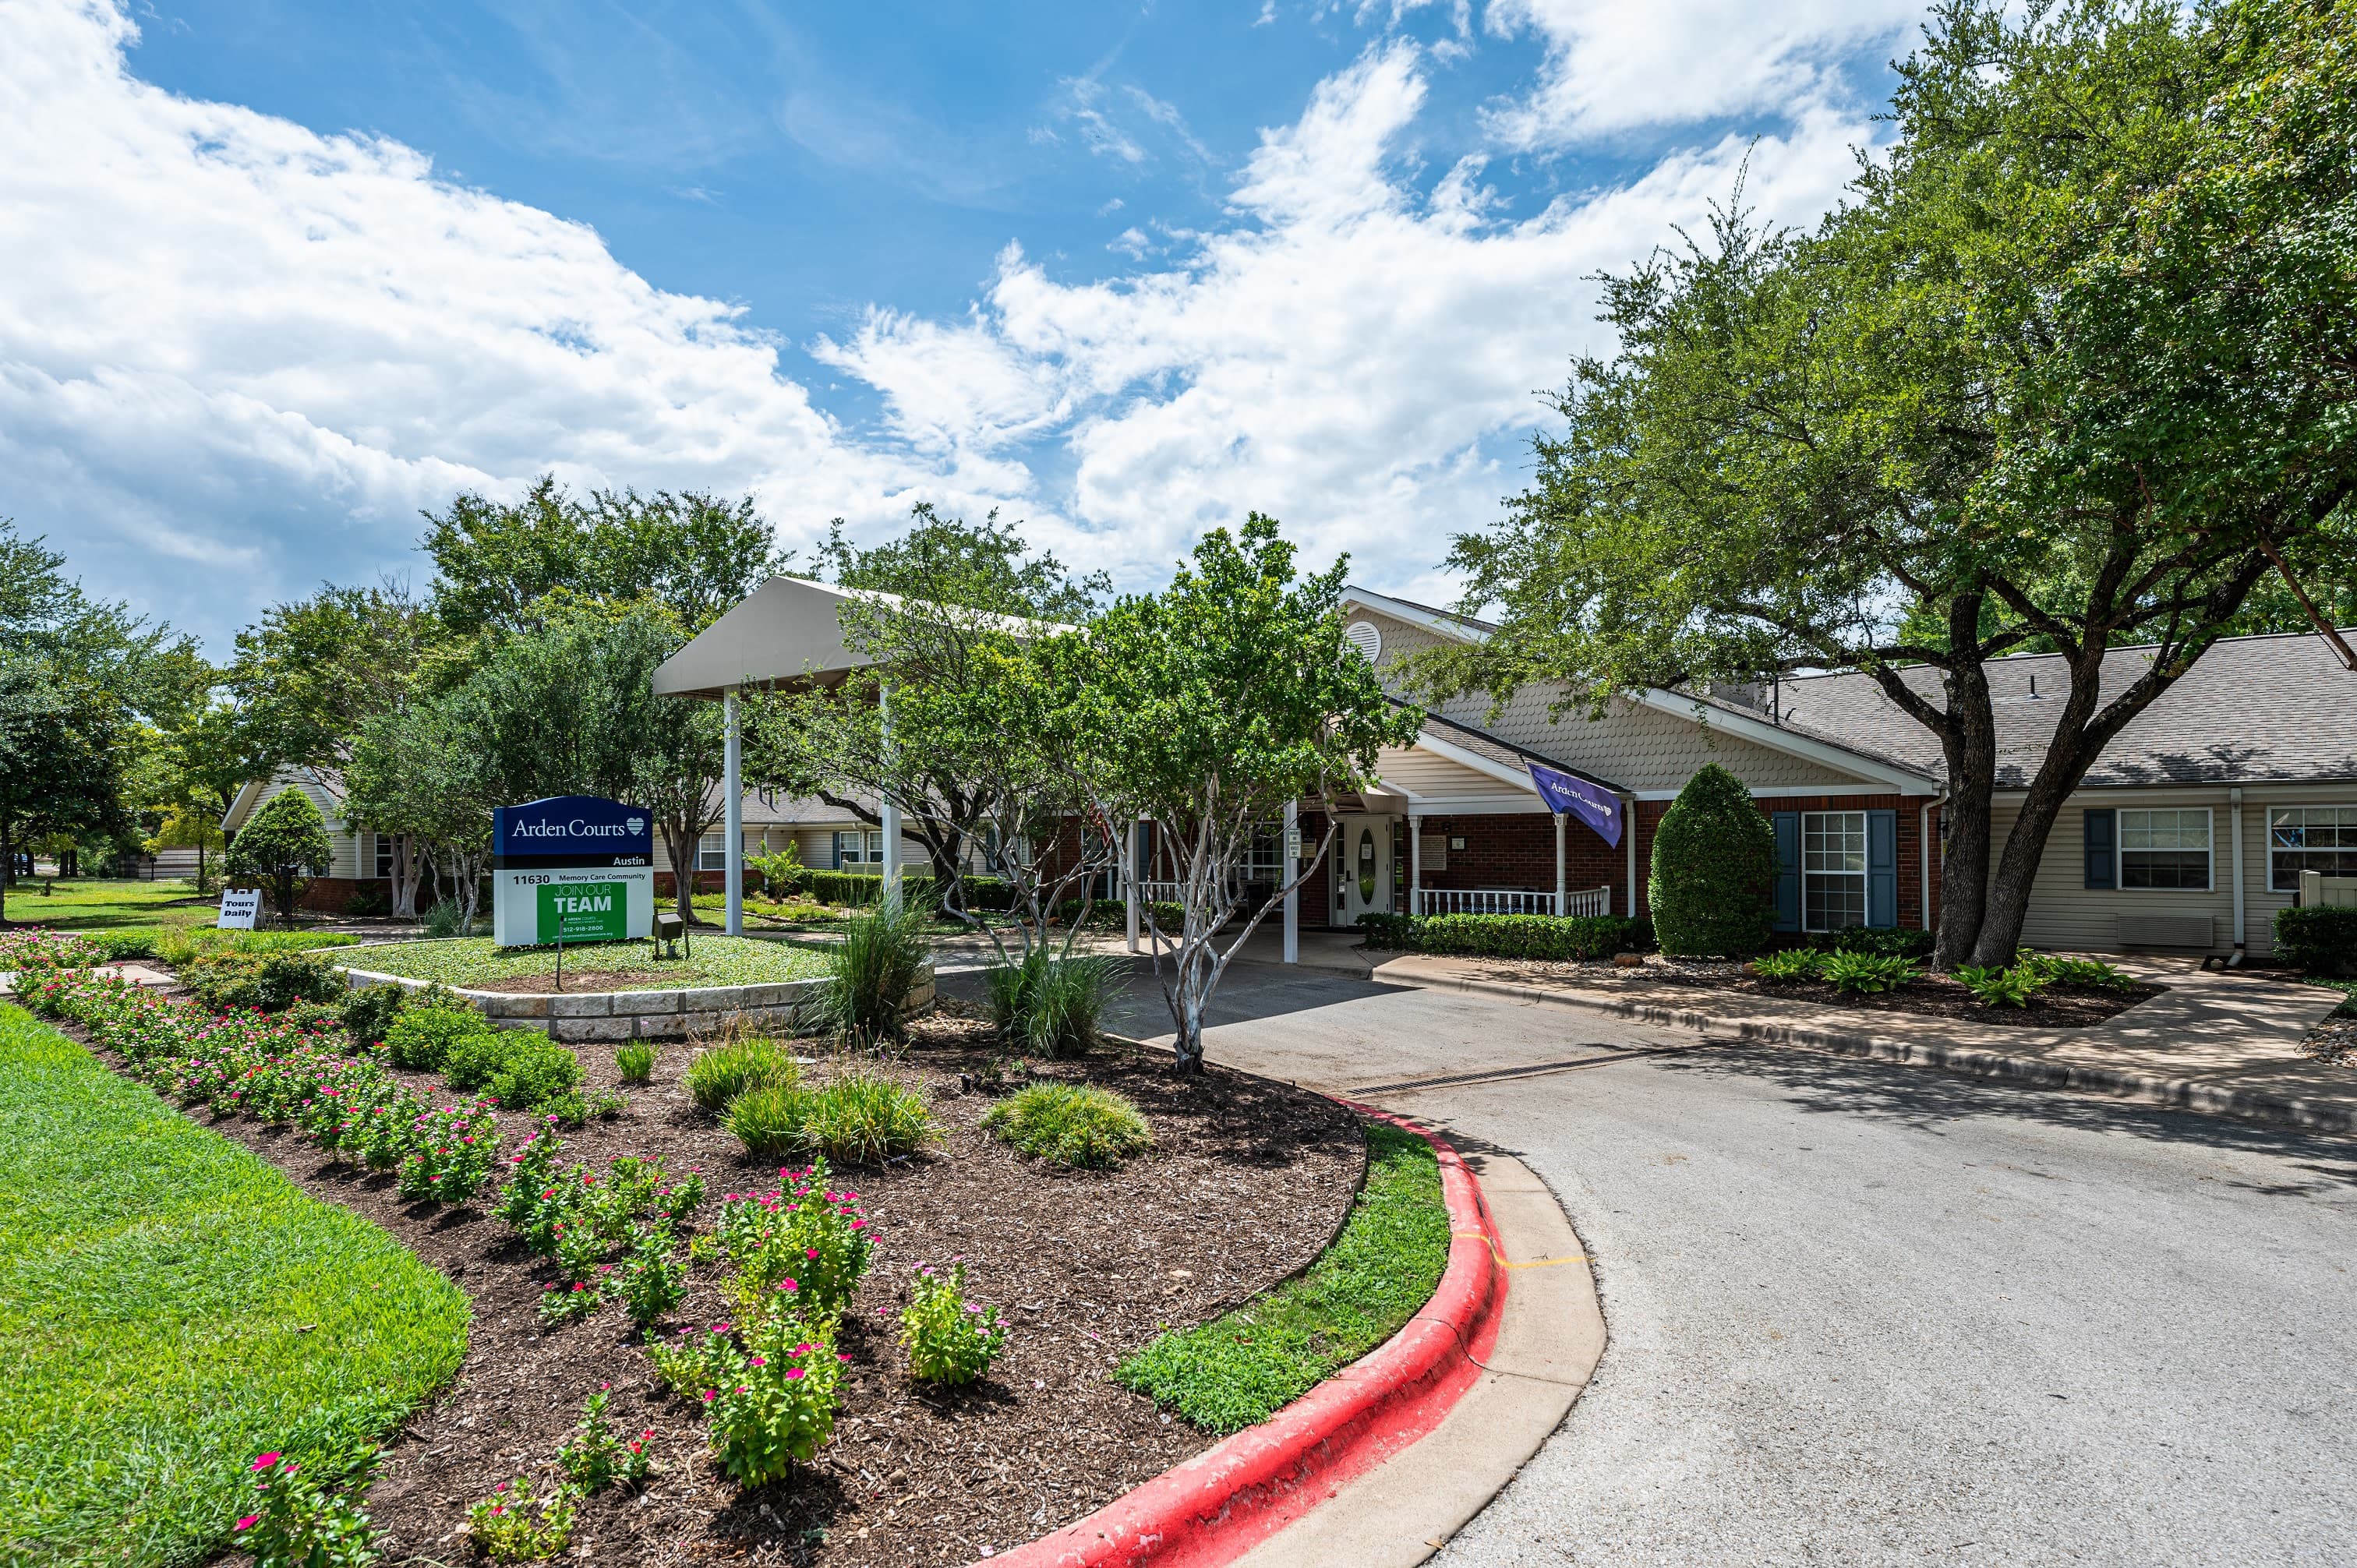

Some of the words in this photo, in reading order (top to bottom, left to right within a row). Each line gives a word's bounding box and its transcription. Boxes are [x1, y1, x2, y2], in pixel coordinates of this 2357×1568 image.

[1551, 782, 1578, 798] Arden
[512, 818, 567, 837] Arden
[569, 819, 625, 836] Courts
[613, 856, 645, 866] Austin
[513, 874, 550, 885] 11630
[559, 874, 588, 882] Memory
[555, 885, 583, 897] JOIN
[585, 884, 611, 895] OUR
[553, 895, 612, 913] TEAM
[224, 909, 252, 918] Daily
